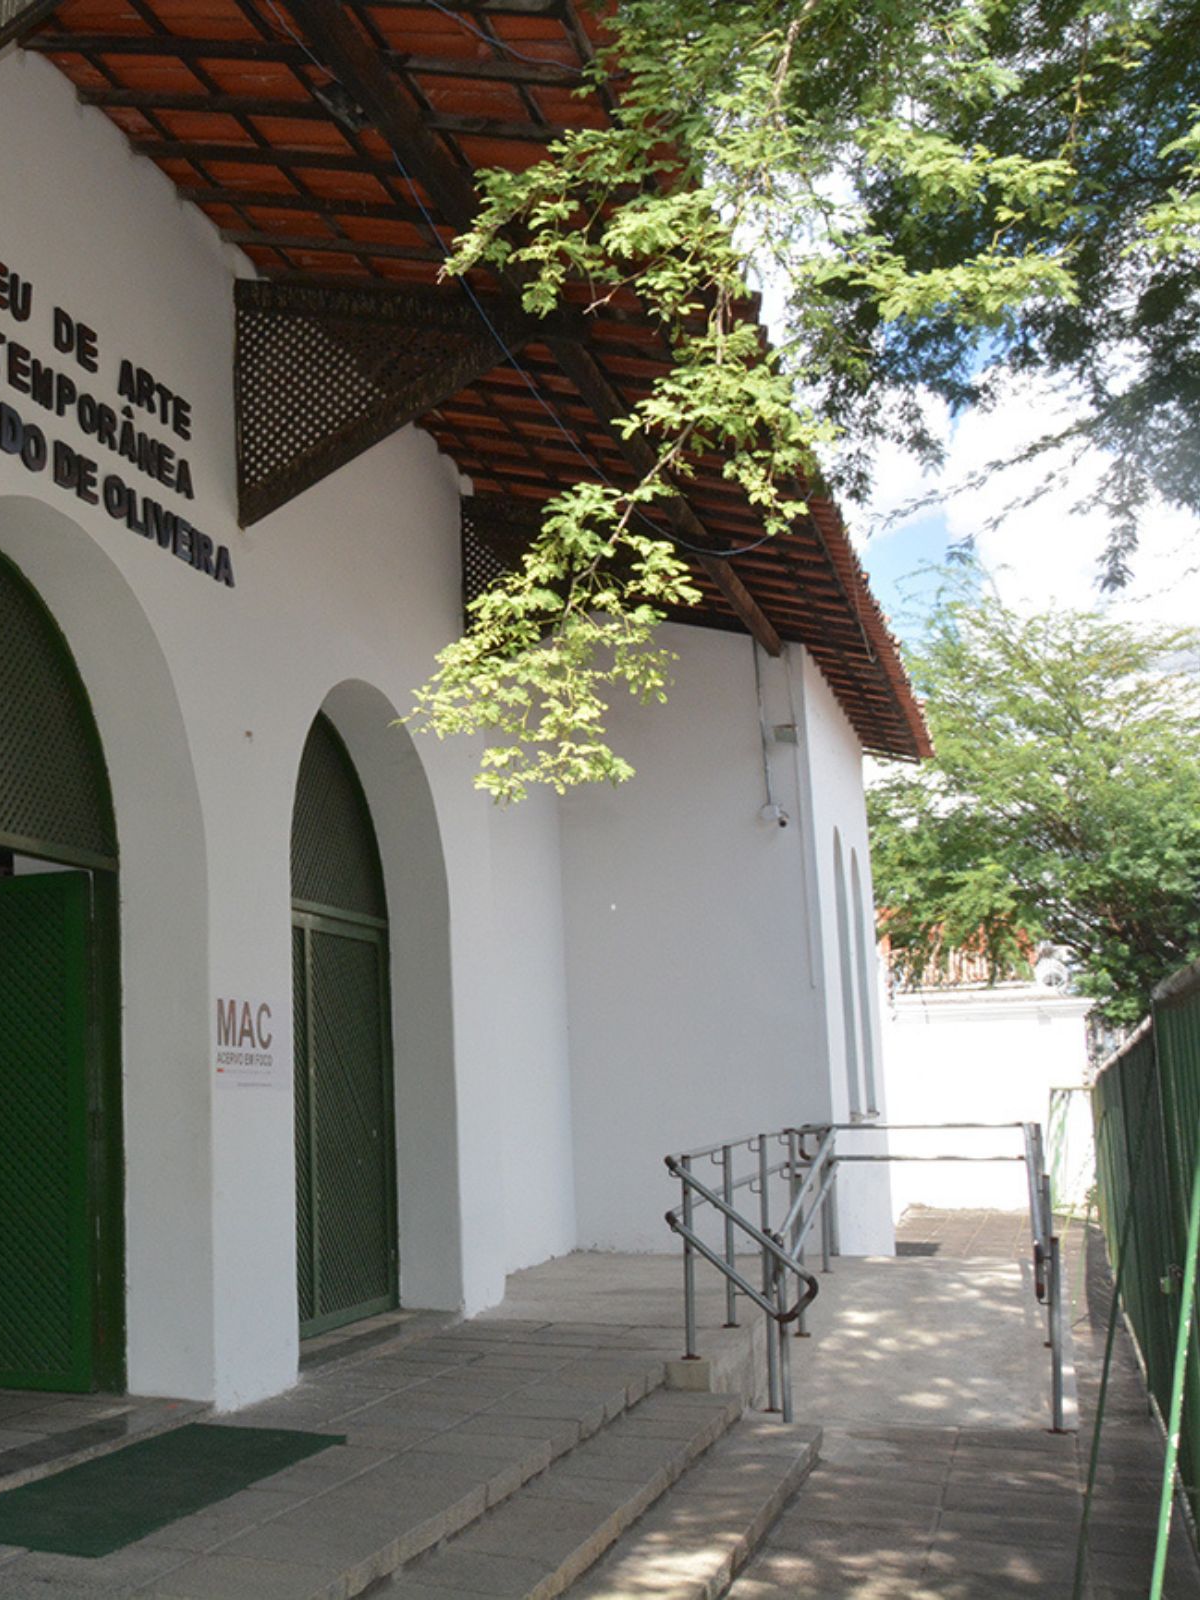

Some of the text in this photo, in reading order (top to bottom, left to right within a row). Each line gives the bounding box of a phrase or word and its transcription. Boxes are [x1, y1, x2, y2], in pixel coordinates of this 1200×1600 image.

[54, 306, 99, 373] DE
[118, 359, 192, 441] ARTE
[53, 440, 99, 506] DE
[103, 474, 235, 588] OLIVEIRA
[217, 998, 273, 1050] MAC
[244, 1053, 254, 1066] EM
